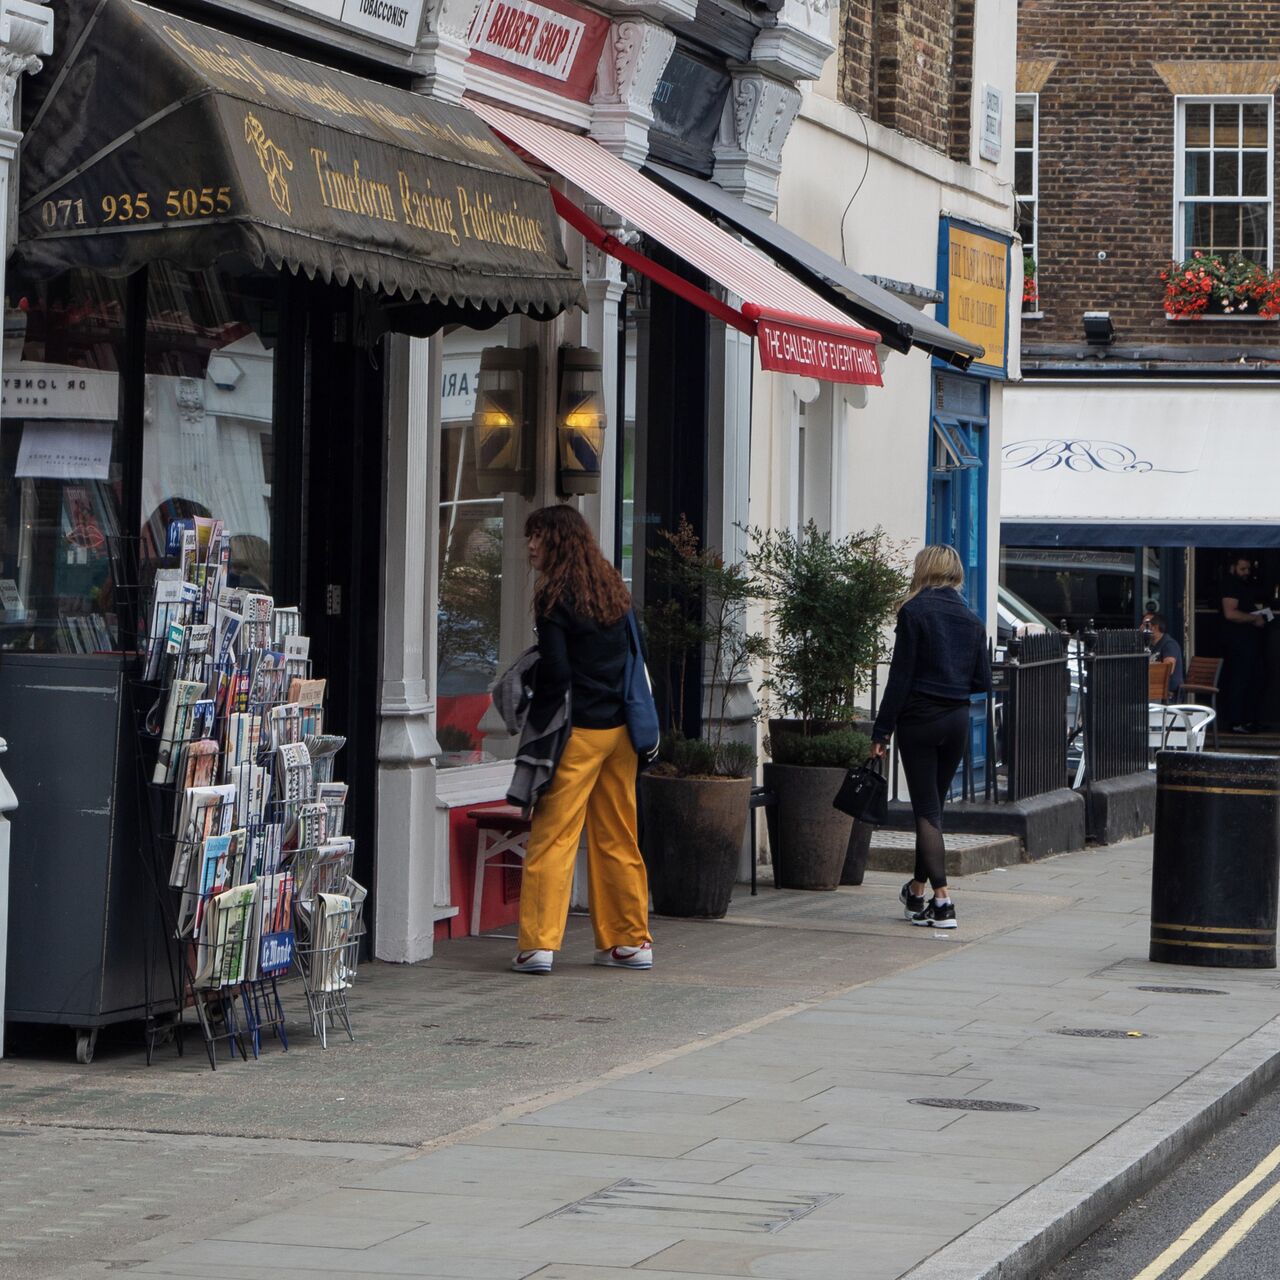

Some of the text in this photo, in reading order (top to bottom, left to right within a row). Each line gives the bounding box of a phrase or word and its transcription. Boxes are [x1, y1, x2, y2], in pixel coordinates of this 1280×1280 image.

[487, 2, 571, 67] BARBER SHOP
[41, 187, 232, 227] 071 935 5055
[310, 147, 547, 253] Timeform Racing Publications
[765, 328, 878, 375] THE GALLERY OF EVERYTHING
